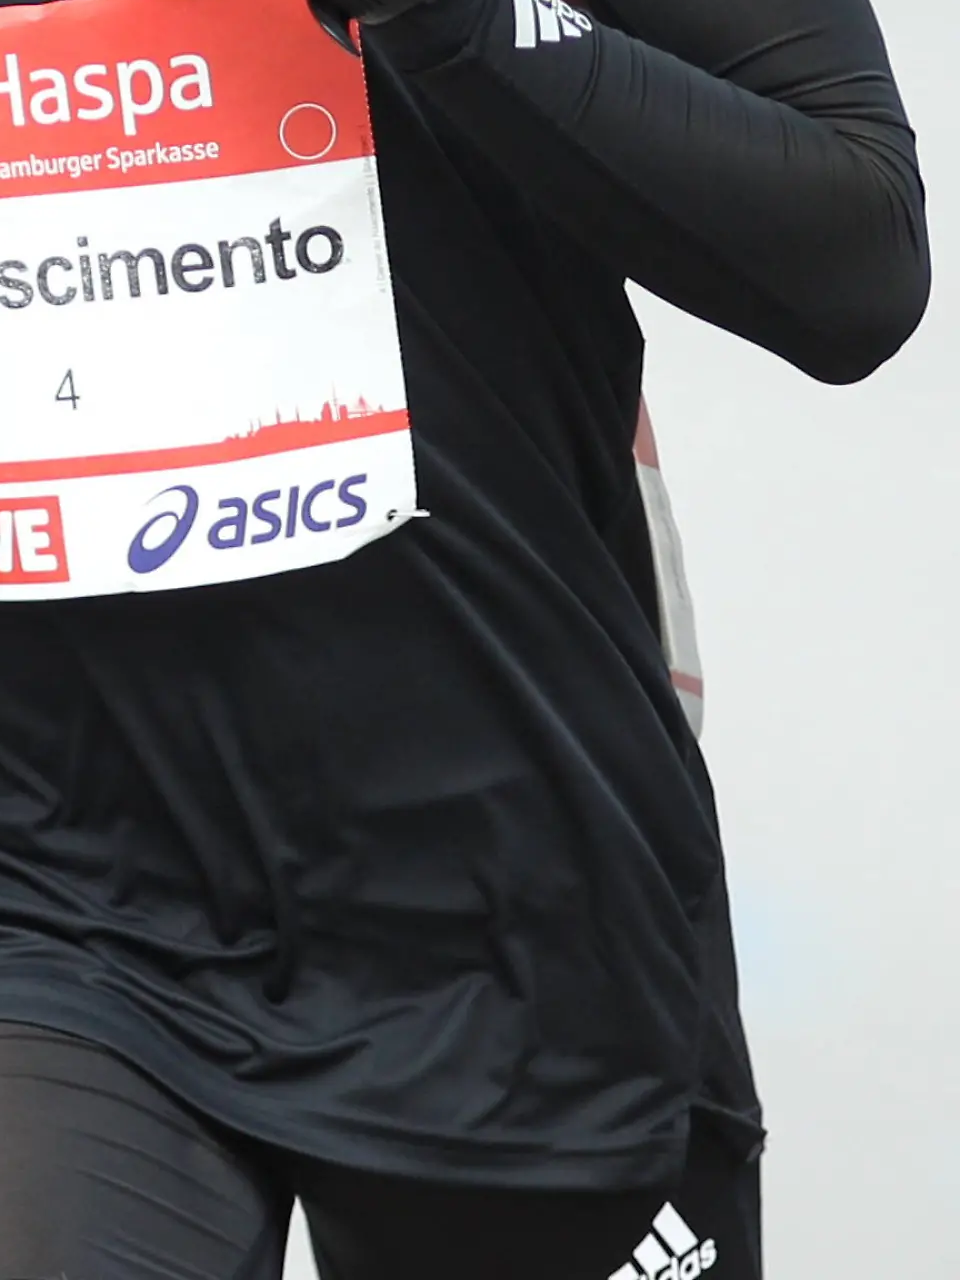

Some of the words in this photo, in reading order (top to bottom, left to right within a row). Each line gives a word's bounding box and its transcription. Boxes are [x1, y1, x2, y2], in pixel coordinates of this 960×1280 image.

[105, 141, 220, 173] Sparkasse
[54, 368, 81, 410] 4
[639, 1237, 718, 1280] das
